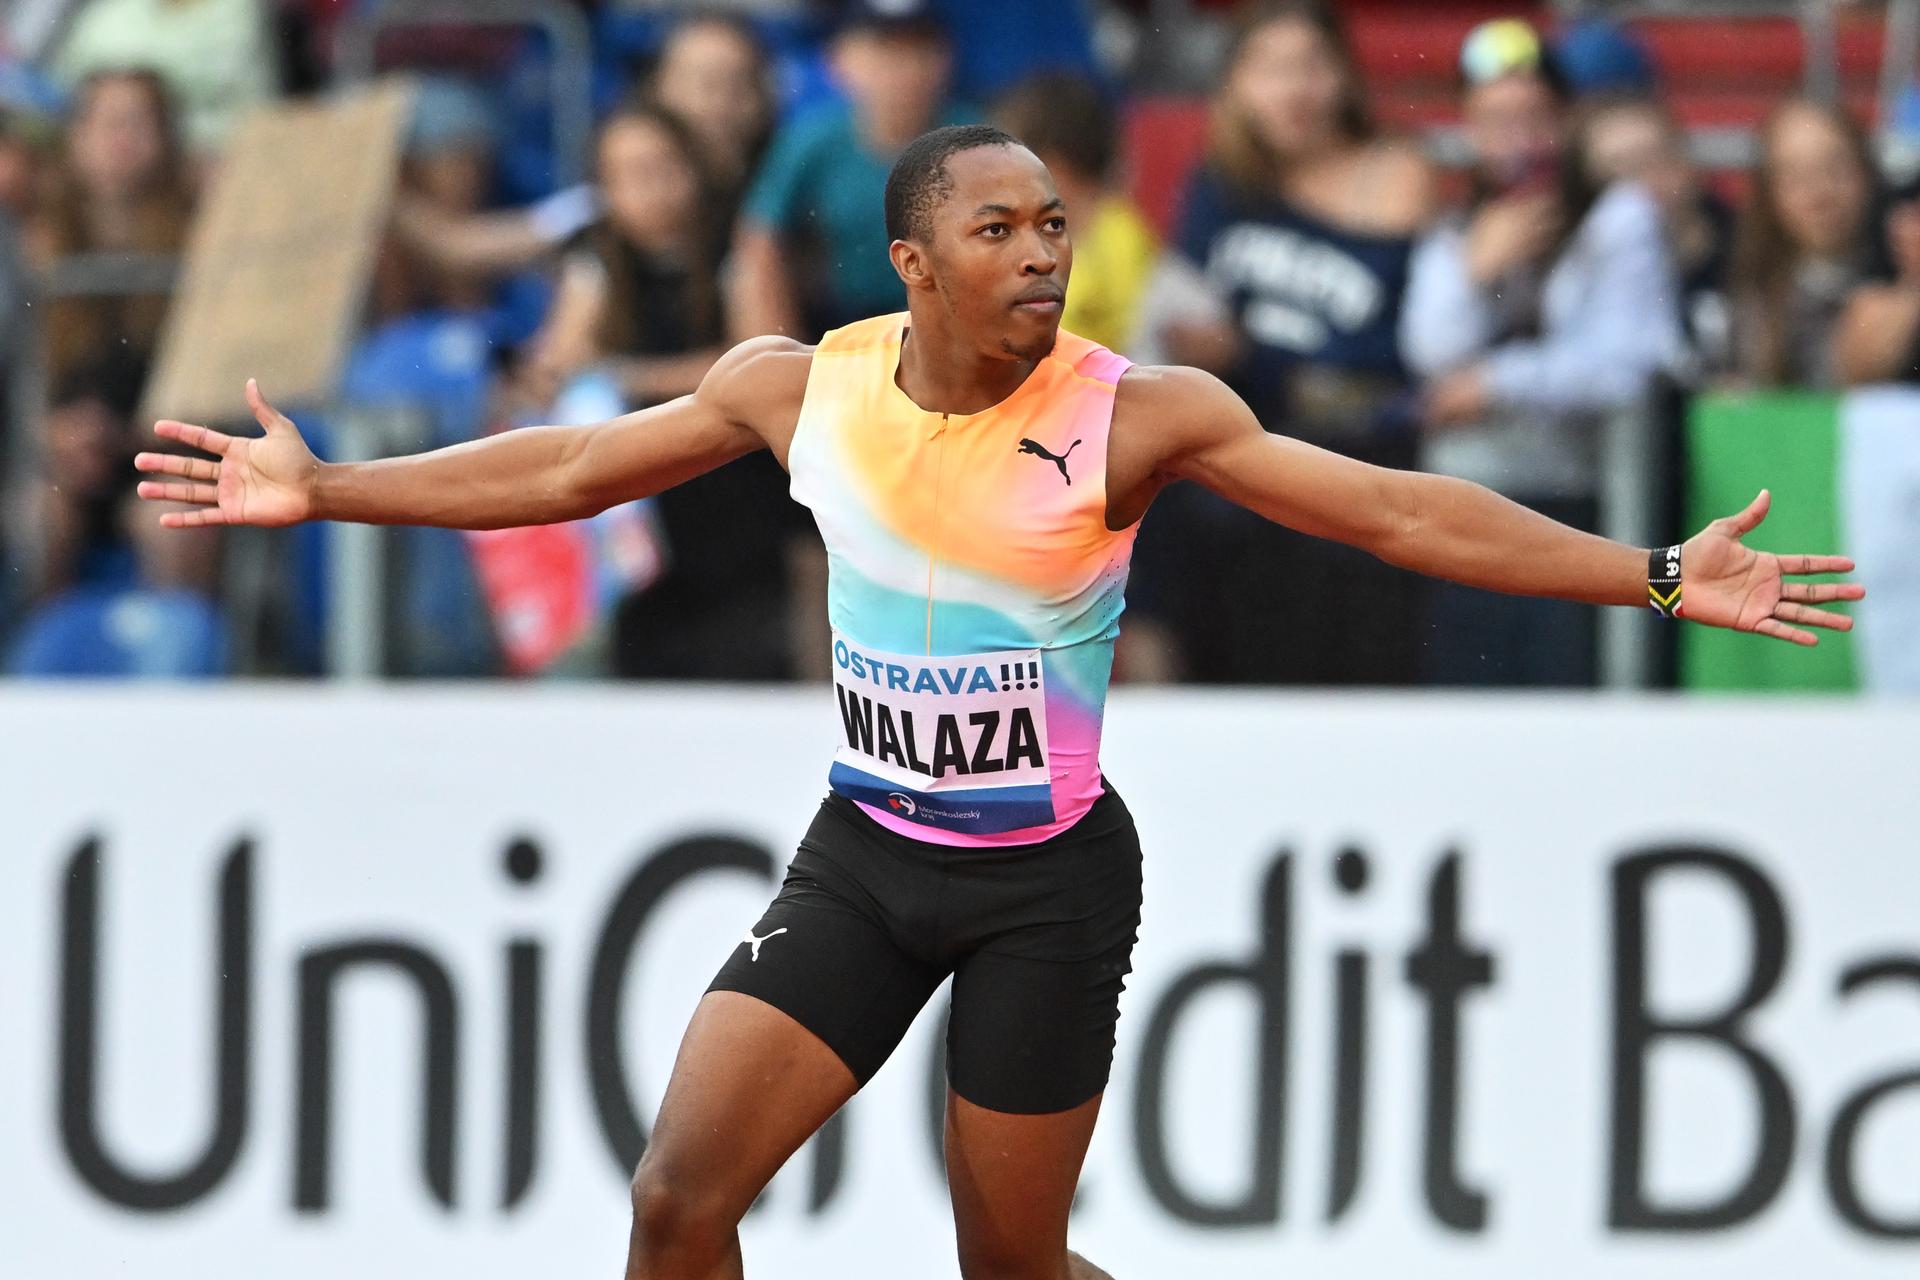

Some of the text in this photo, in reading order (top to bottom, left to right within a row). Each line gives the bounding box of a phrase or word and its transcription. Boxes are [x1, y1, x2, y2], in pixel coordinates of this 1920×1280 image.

[834, 639, 1039, 695] OSTRAVA!!!
[836, 682, 1045, 779] WALAZA
[57, 832, 1497, 1234] UniCdit
